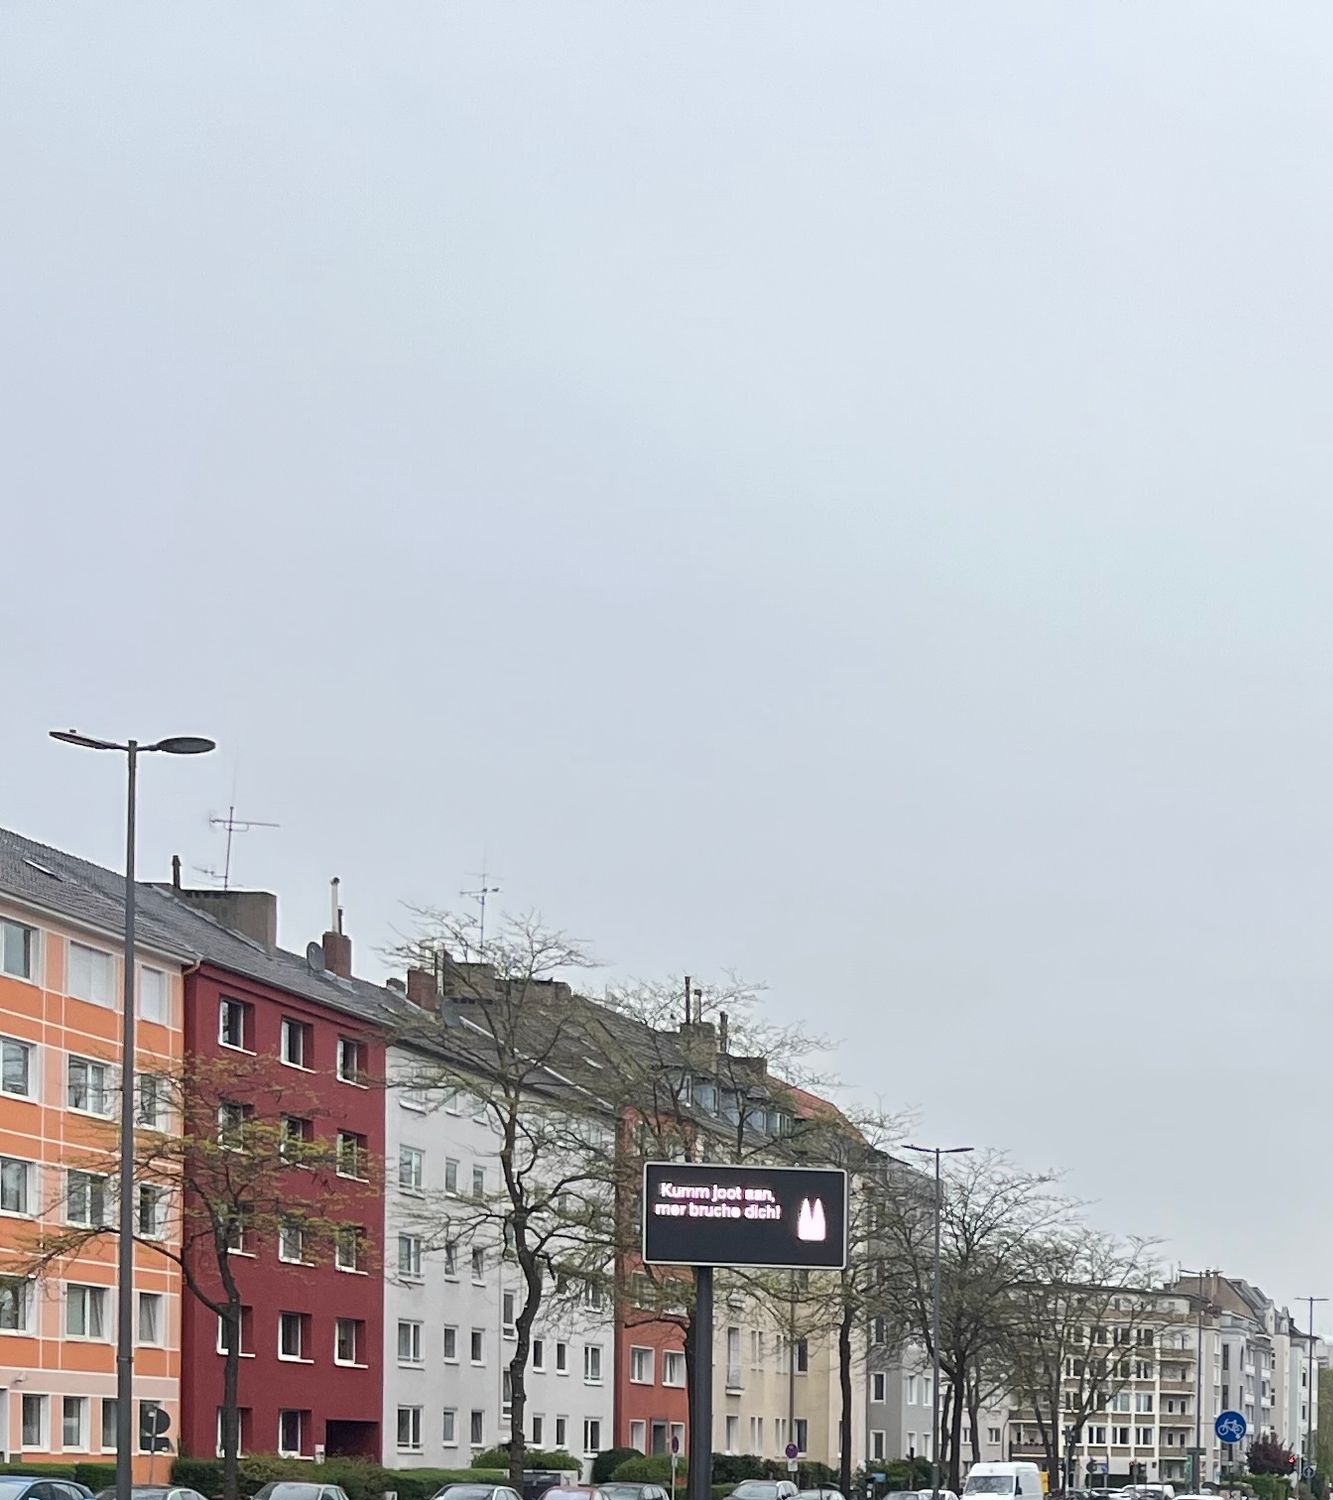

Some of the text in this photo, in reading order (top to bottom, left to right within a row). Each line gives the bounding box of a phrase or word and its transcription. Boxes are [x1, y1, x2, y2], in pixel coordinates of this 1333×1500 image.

[660, 1182, 710, 1199] Kumm
[711, 1184, 741, 1202] joot
[655, 1202, 781, 1219] mer bruche dich!
